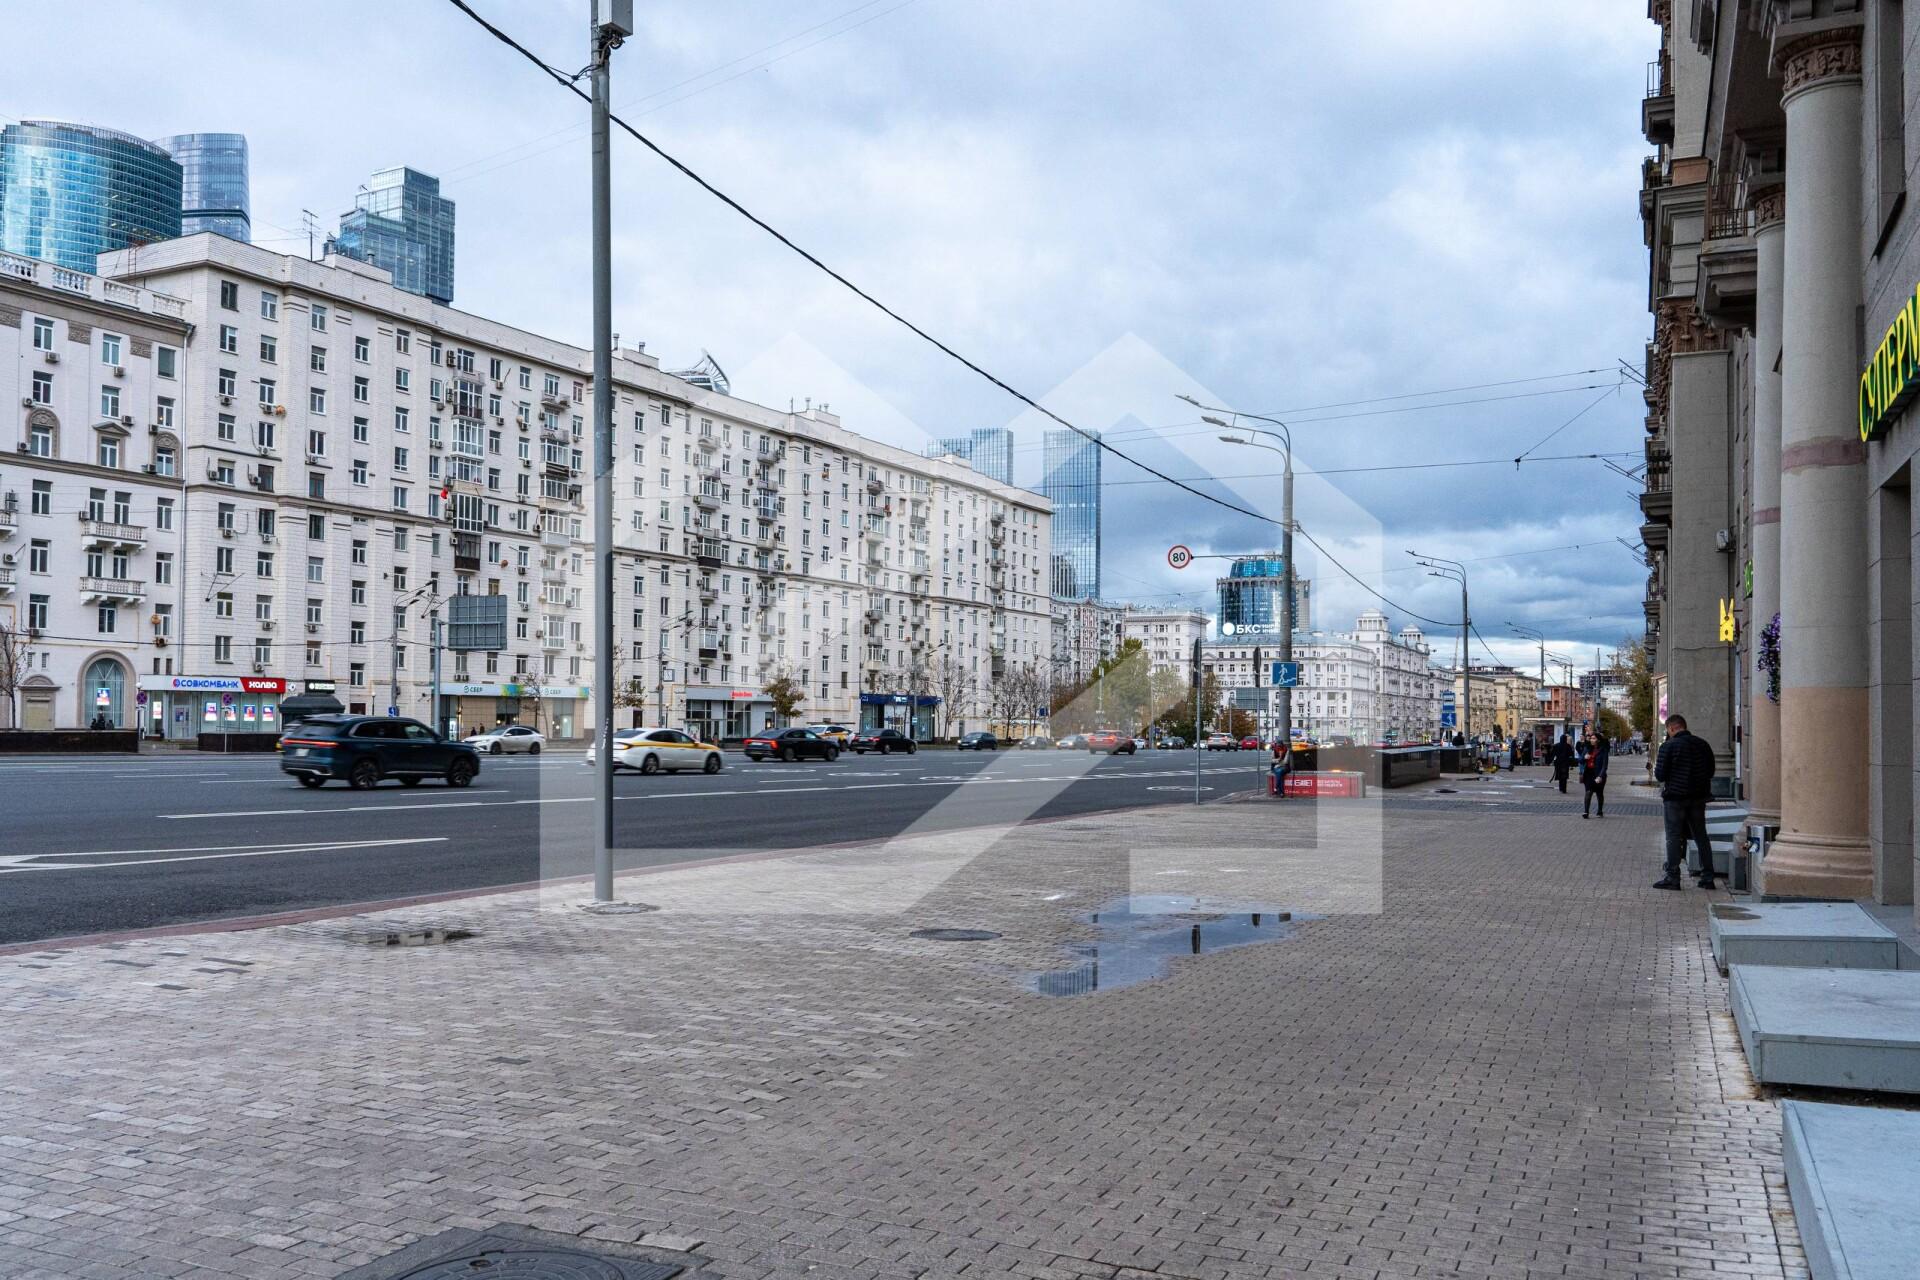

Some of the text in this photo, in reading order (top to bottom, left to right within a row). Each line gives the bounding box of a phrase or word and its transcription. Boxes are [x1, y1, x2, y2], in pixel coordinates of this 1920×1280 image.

[1172, 552, 1186, 562] 80
[1236, 624, 1261, 634] БКС
[181, 679, 239, 689] СОВКОМБАНК
